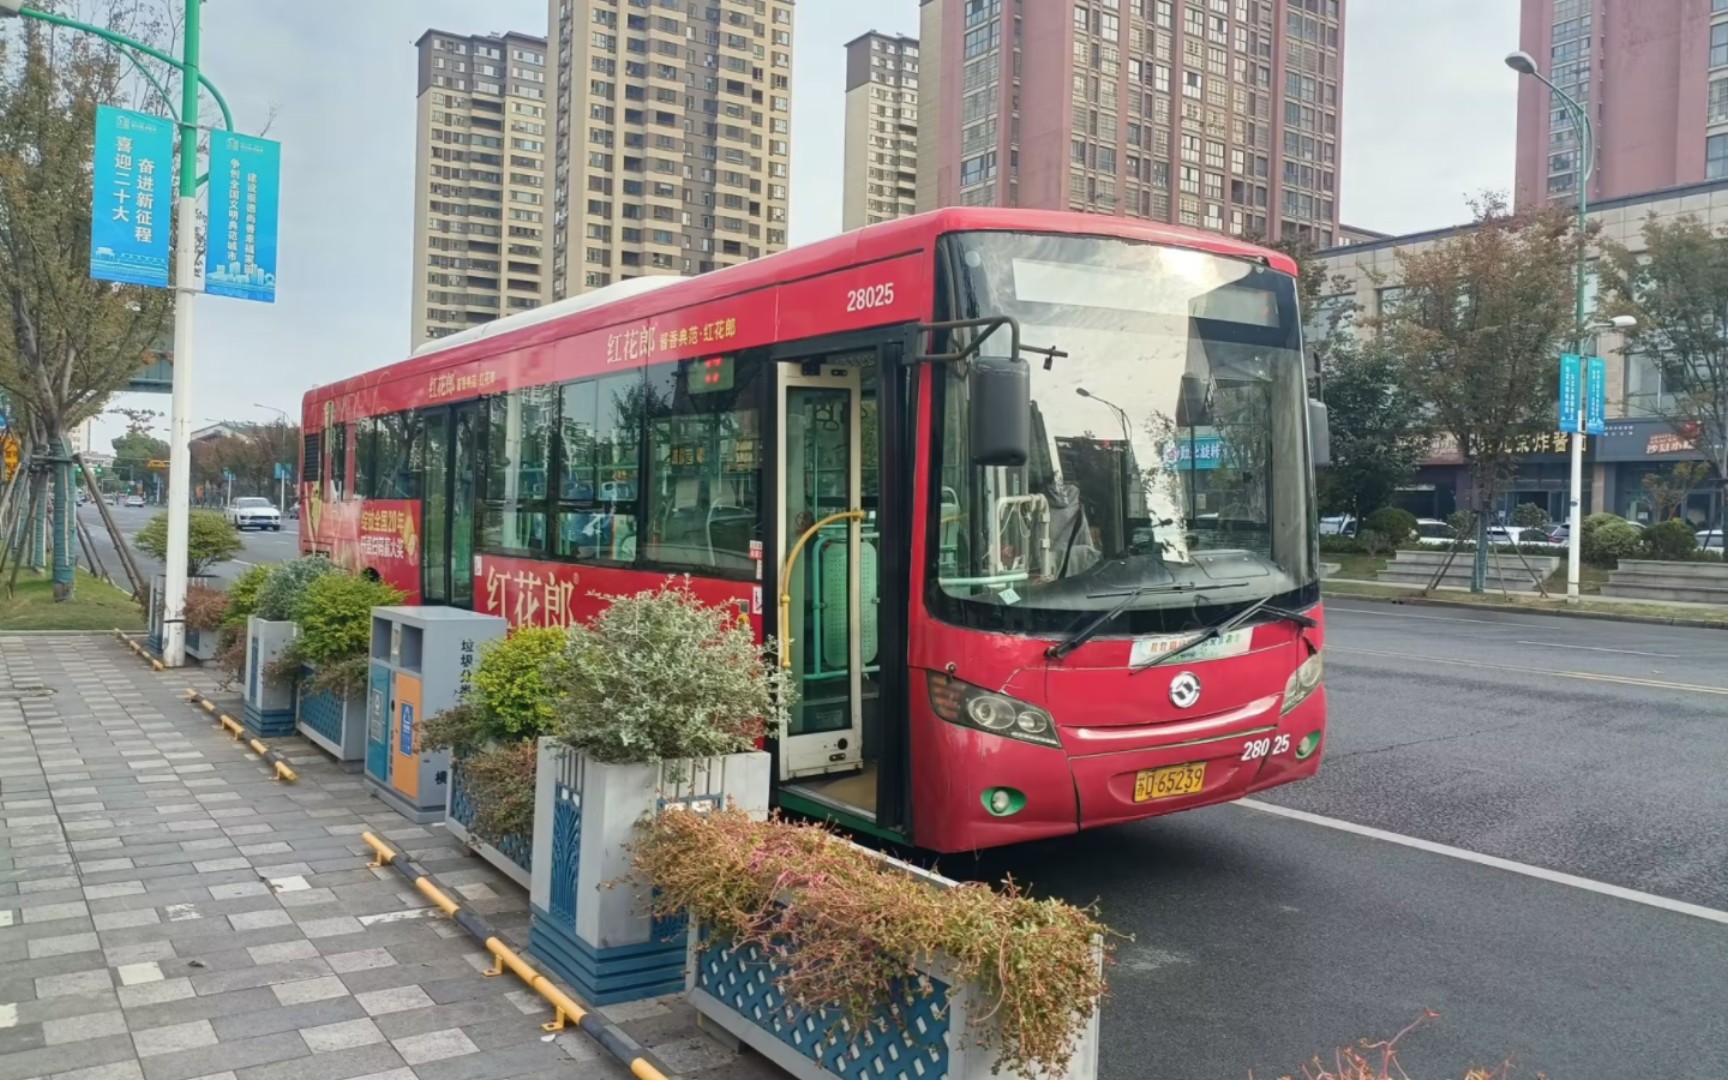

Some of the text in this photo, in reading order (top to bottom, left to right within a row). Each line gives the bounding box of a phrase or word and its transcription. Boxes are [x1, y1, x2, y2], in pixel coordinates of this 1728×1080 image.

[112, 136, 133, 223] 喜迎二十大
[134, 158, 156, 244] 奋进新征程
[846, 282, 895, 313] 28025
[606, 325, 657, 365] 红花郎
[486, 565, 575, 629] 红花郎
